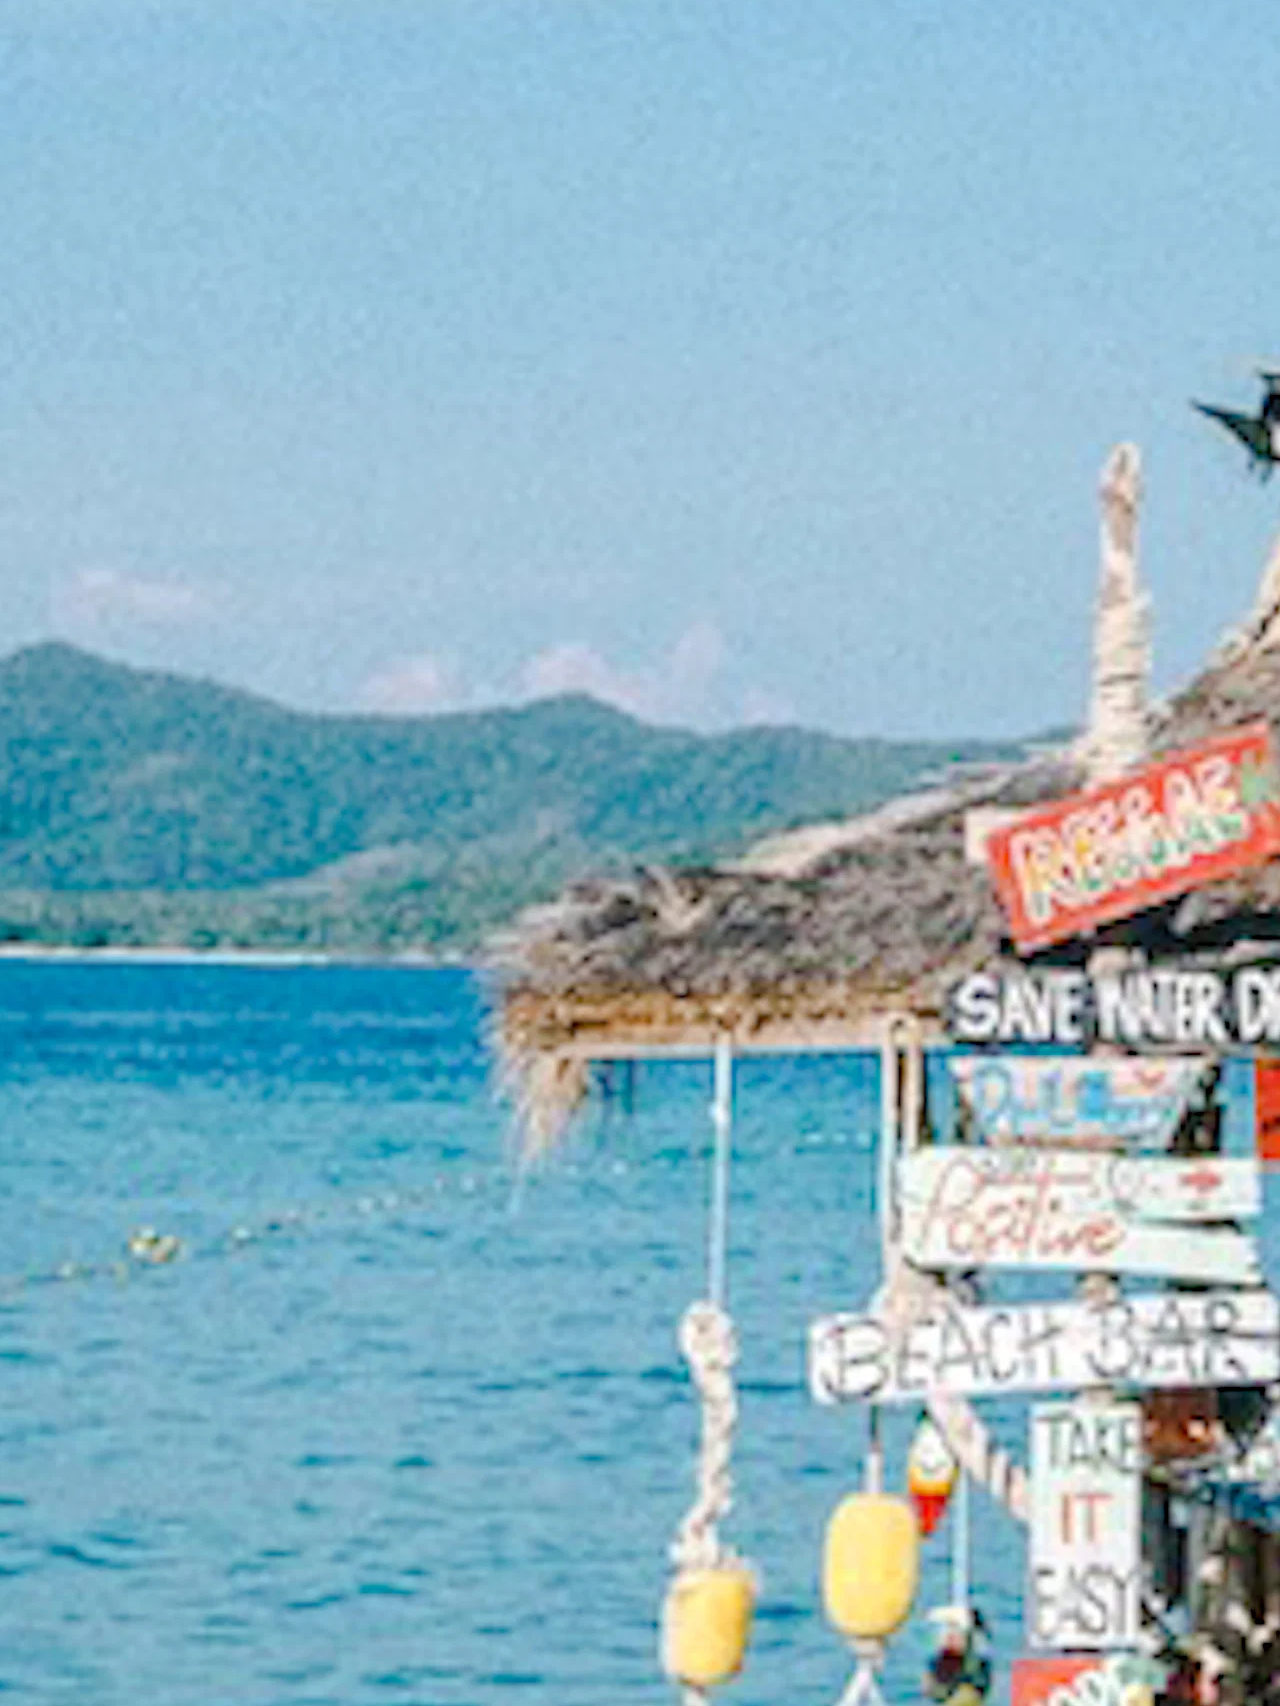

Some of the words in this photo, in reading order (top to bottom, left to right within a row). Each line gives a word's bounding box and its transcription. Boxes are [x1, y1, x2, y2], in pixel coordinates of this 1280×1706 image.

[955, 976, 1085, 1044] SAVE
[1095, 968, 1224, 1045] WATER
[823, 1301, 1062, 1401] BEACH
[1086, 1297, 1248, 1380] BAR
[1043, 1410, 1141, 1474] TAKE
[1060, 1491, 1114, 1545] IT
[1033, 1561, 1152, 1641] EASY
